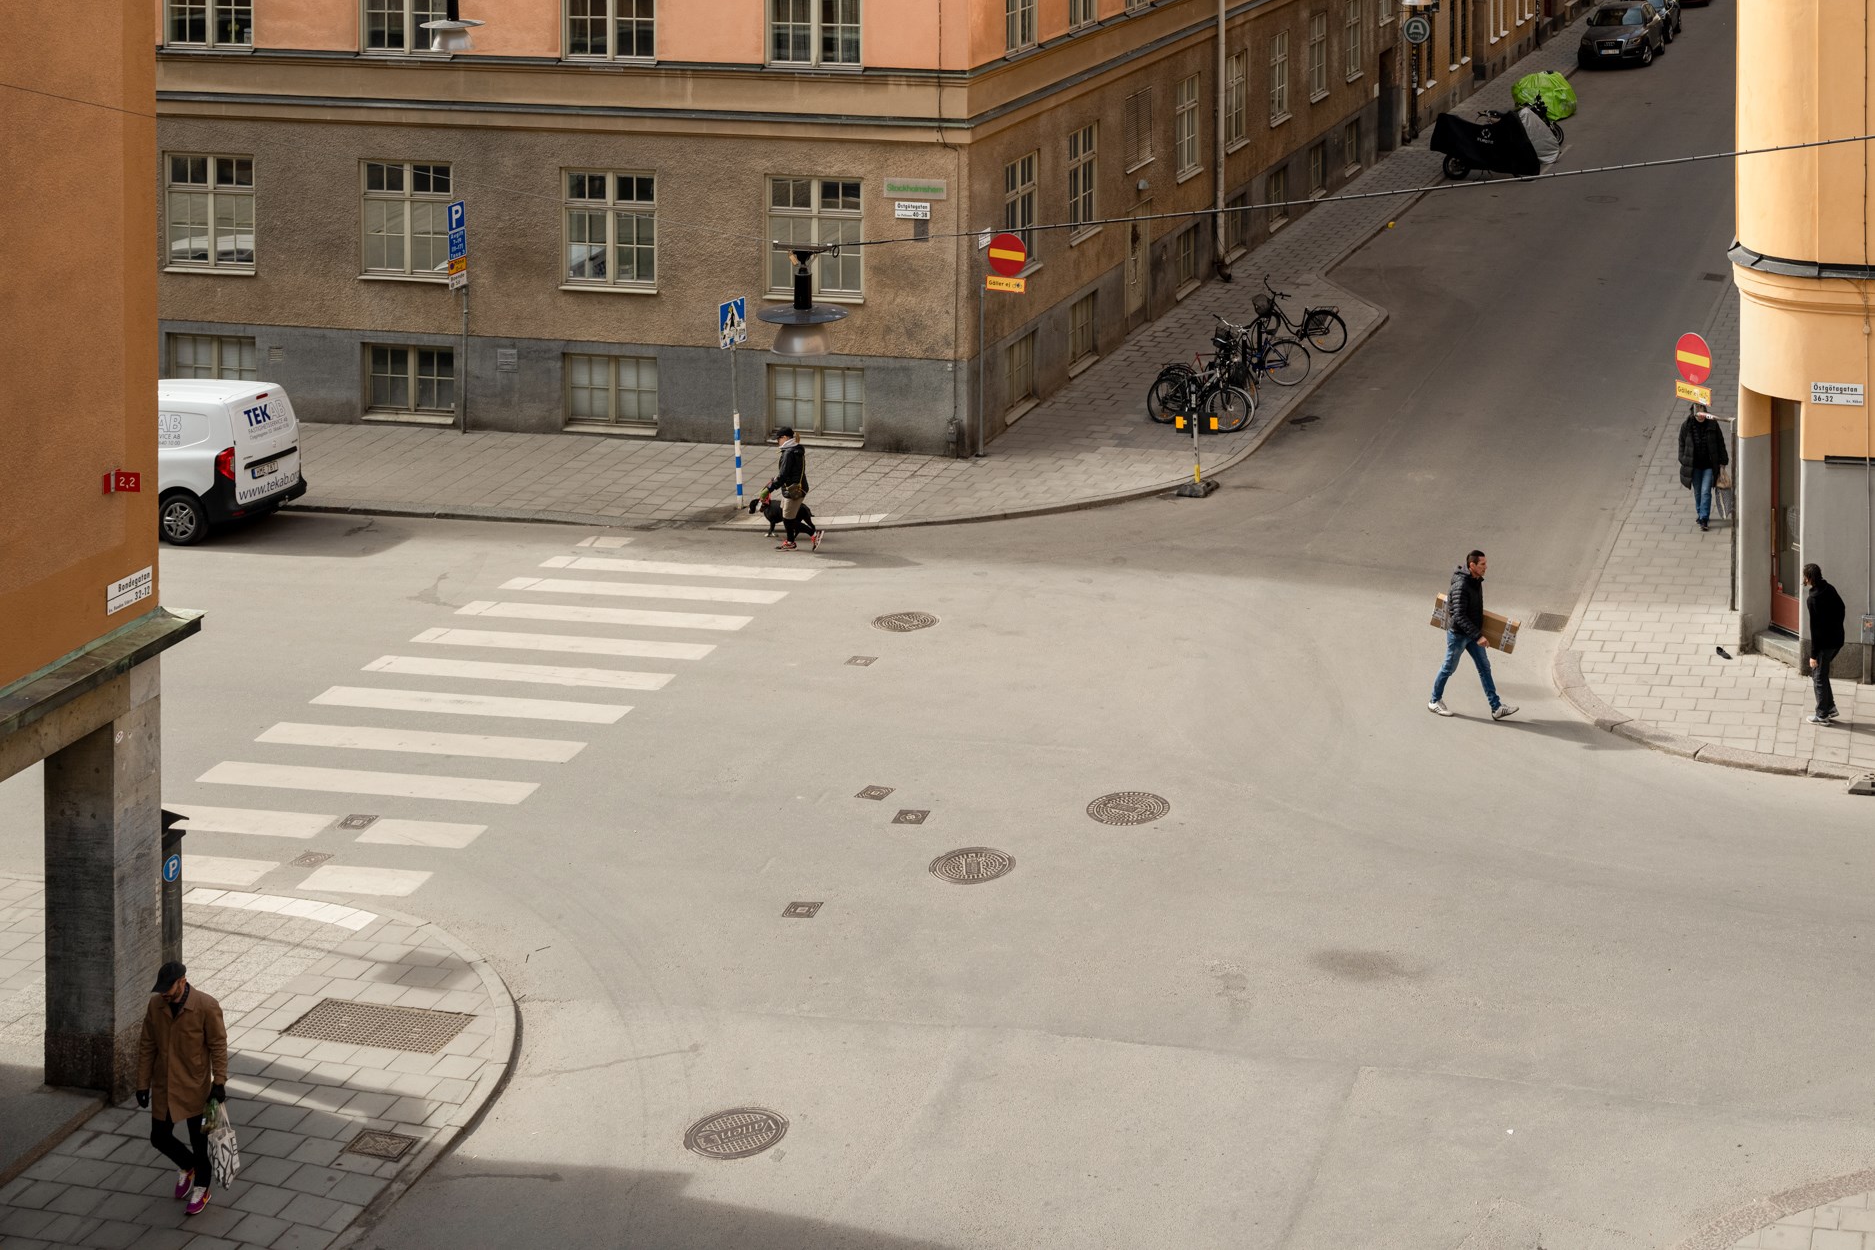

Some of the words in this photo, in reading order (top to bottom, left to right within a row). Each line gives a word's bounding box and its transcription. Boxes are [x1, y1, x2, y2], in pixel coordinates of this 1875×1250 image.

[452, 205, 462, 229] P
[1813, 383, 1858, 394] Östgötagatan
[1813, 395, 1834, 403] 36-32
[120, 476, 136, 489] 2,2
[118, 571, 151, 594] Bondegatan
[134, 585, 151, 601] 32-12
[169, 858, 178, 878] P
